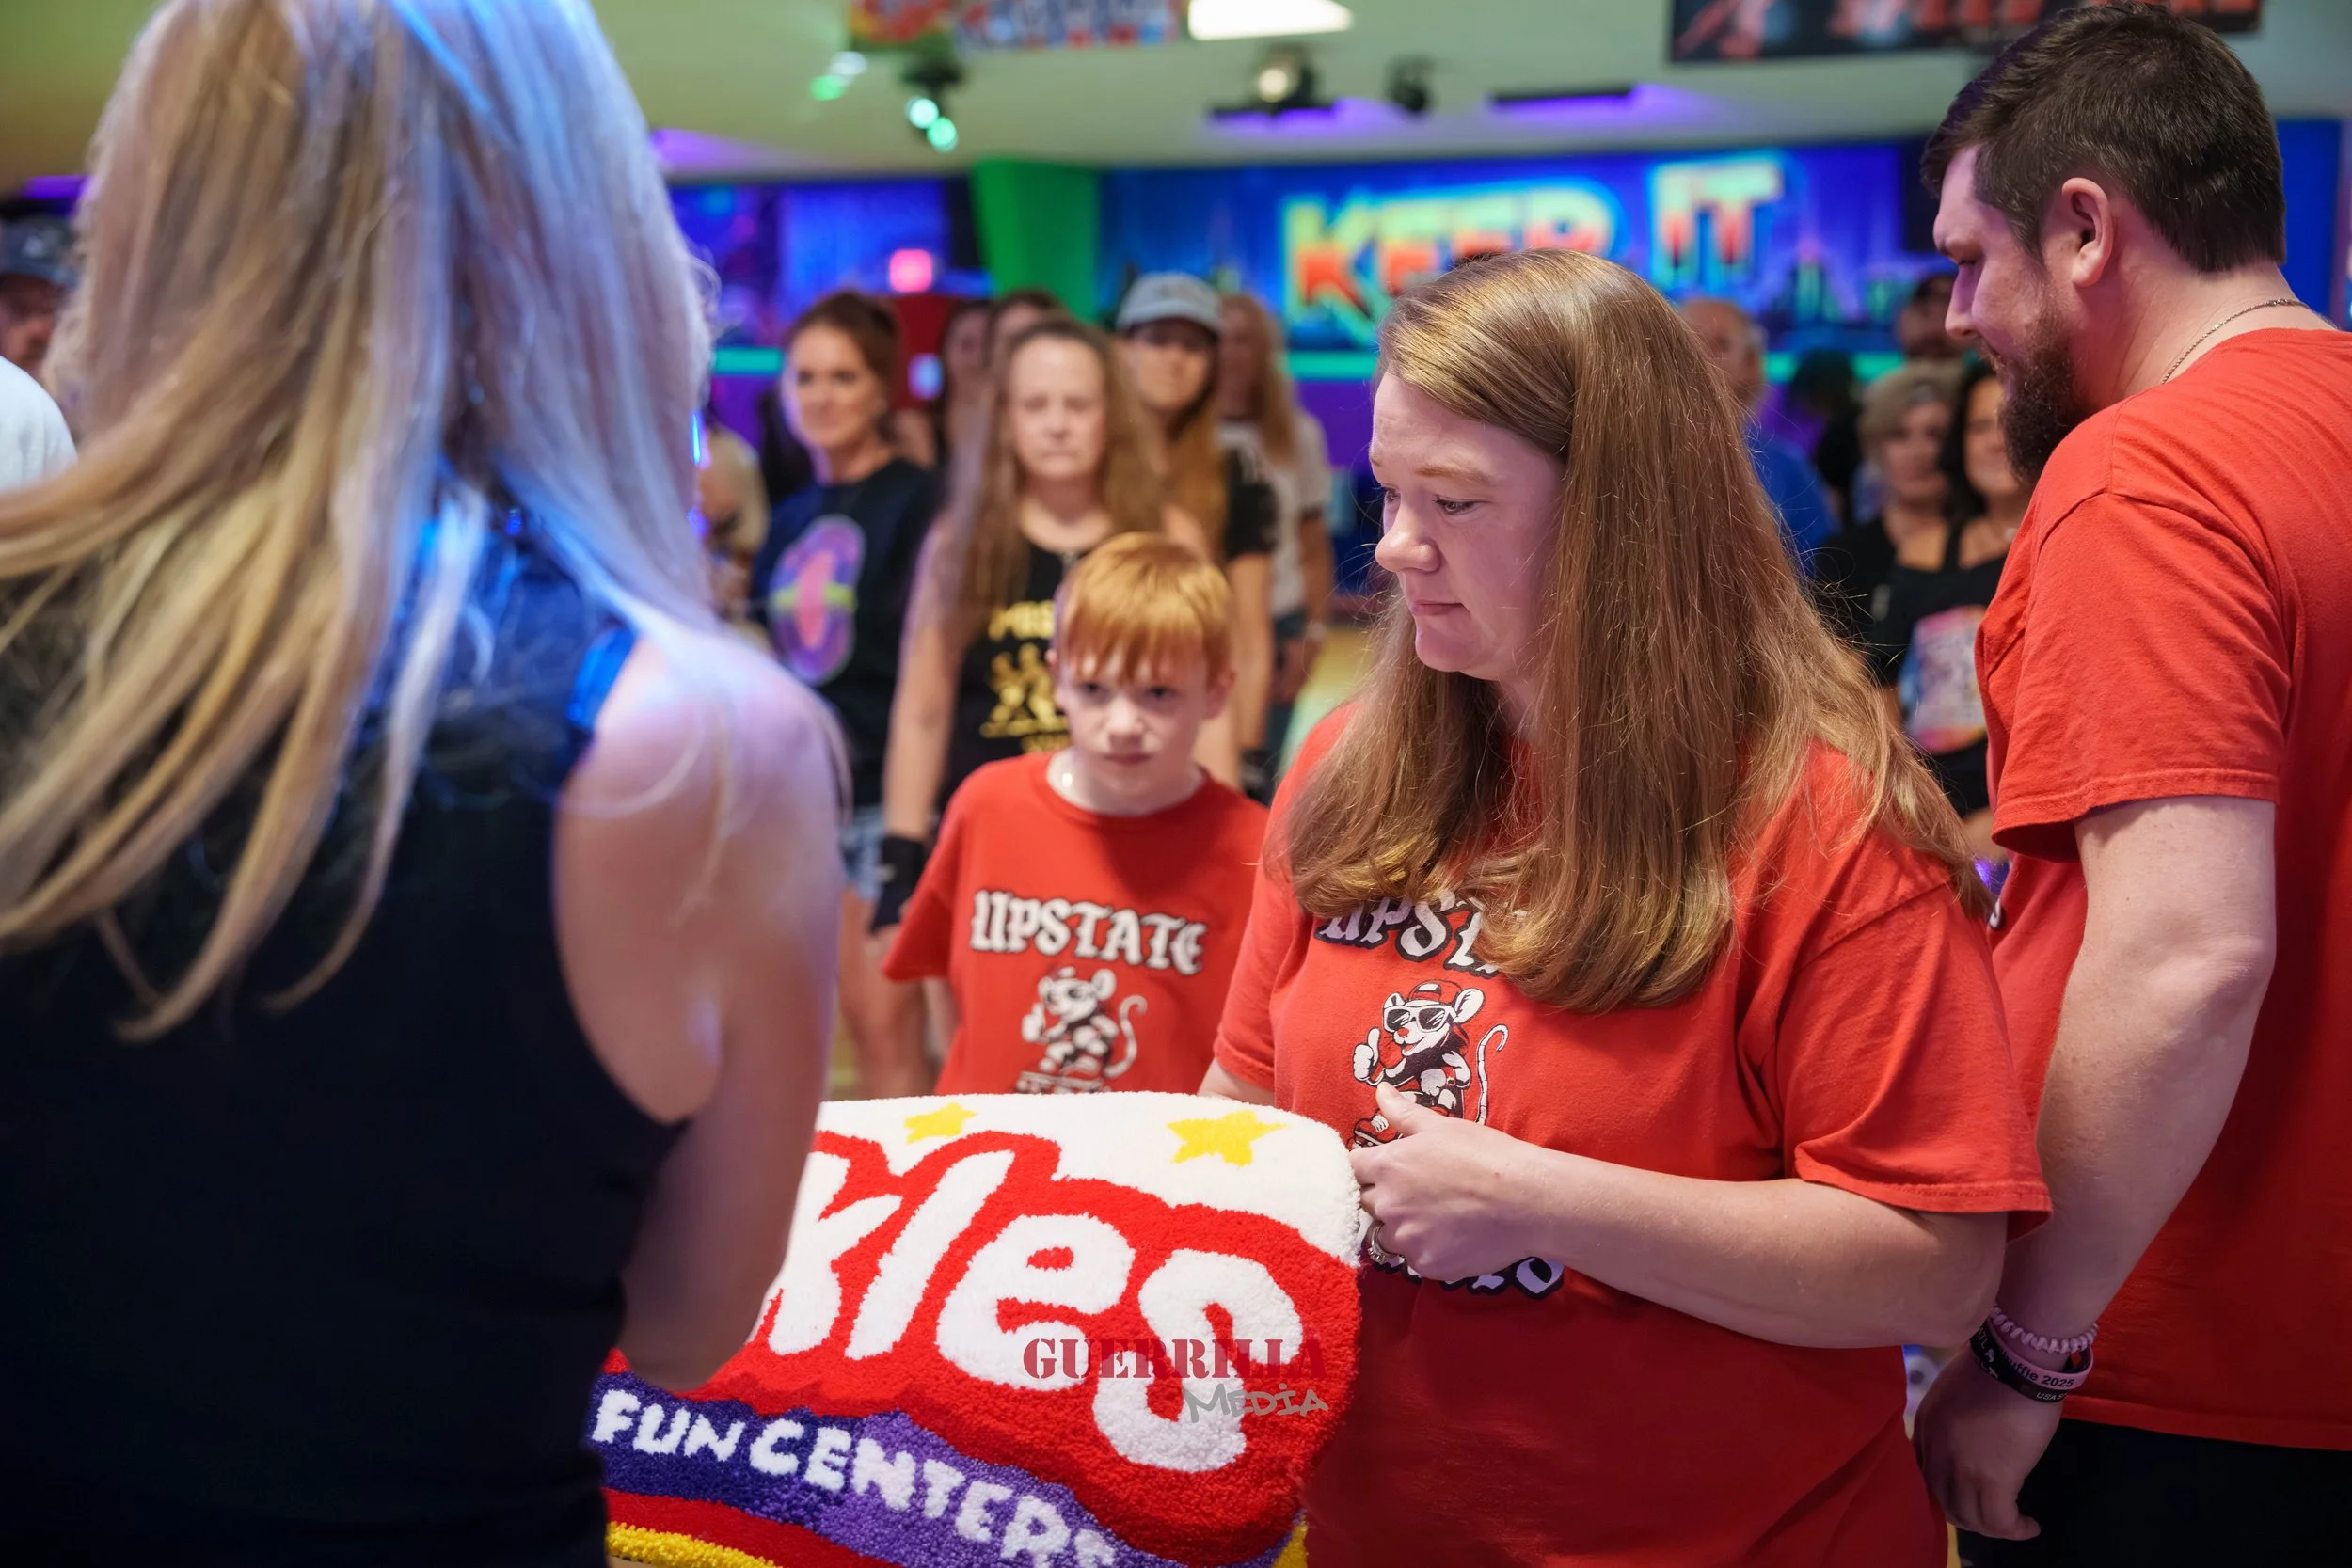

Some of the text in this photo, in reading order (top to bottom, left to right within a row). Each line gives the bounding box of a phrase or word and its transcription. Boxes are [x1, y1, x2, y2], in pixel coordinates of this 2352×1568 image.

[1652, 160, 1783, 282] IT
[970, 889, 1207, 976] UPSTATE
[753, 1149, 1304, 1473] kles
[2042, 1375, 2074, 1388] 2025
[592, 1389, 746, 1462] FUN
